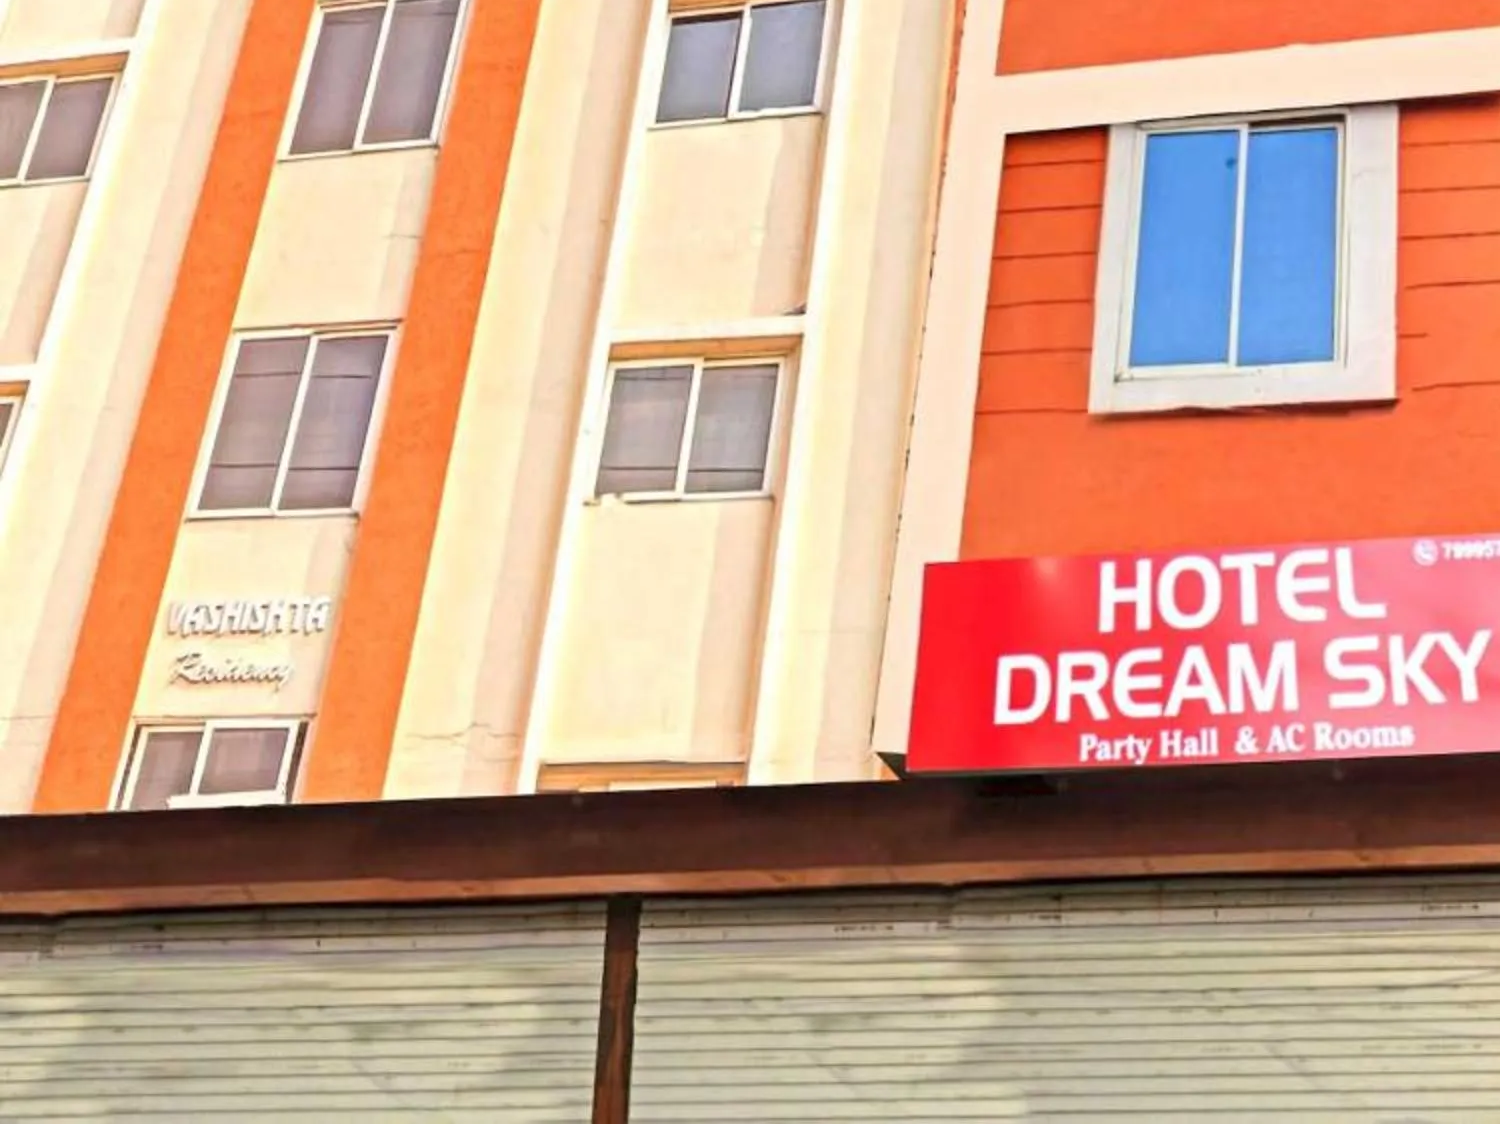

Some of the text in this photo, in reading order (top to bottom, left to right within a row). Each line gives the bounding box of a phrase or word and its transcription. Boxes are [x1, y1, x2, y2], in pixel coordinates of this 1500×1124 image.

[168, 597, 332, 637] VASHISHTA
[1098, 547, 1387, 633] HOTEL
[993, 629, 1493, 725] DREAM SKY
[1078, 722, 1414, 765] Party Hall & AC Rooms
